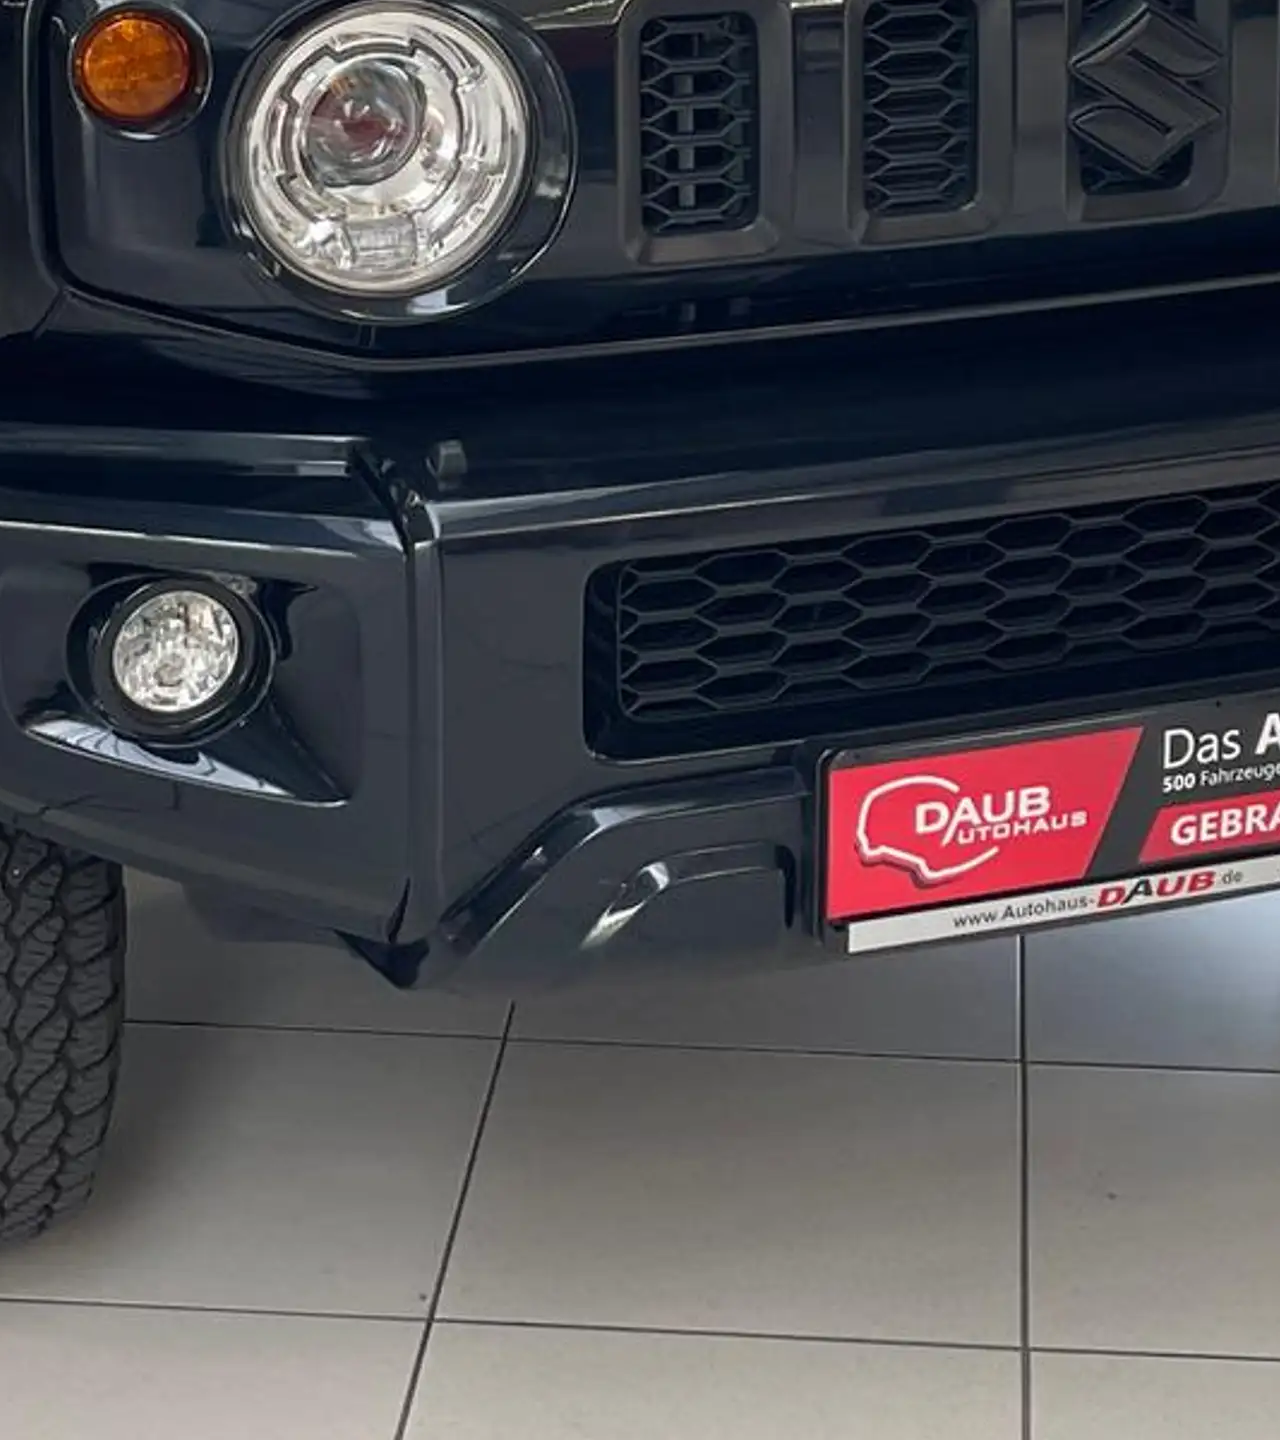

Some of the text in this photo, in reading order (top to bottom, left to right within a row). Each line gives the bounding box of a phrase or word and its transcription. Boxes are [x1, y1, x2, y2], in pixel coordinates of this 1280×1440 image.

[1163, 727, 1242, 769] Das
[1162, 772, 1197, 793] 500
[915, 785, 1052, 846] DAUB
